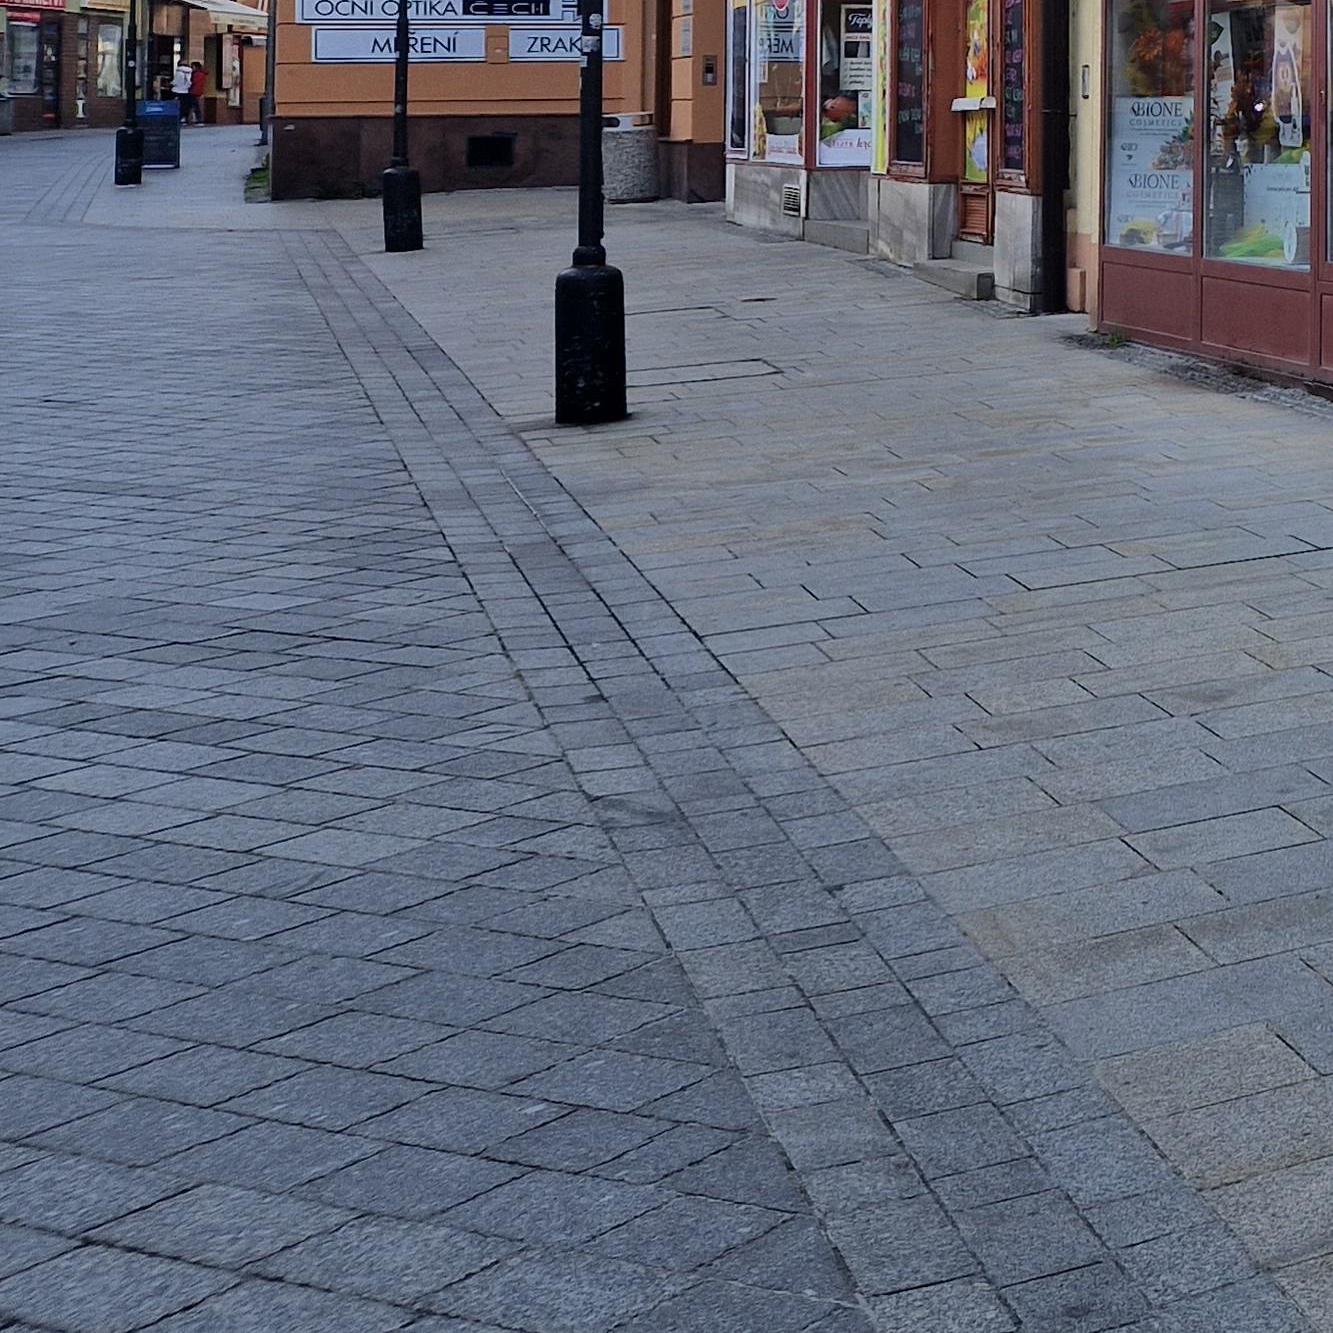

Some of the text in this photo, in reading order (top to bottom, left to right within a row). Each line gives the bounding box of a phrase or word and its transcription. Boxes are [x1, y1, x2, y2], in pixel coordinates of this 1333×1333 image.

[371, 31, 457, 54] MŘENÍ
[527, 36, 584, 54] ZRAK
[1131, 101, 1183, 117] BIONE
[1128, 173, 1180, 189] BIONE
